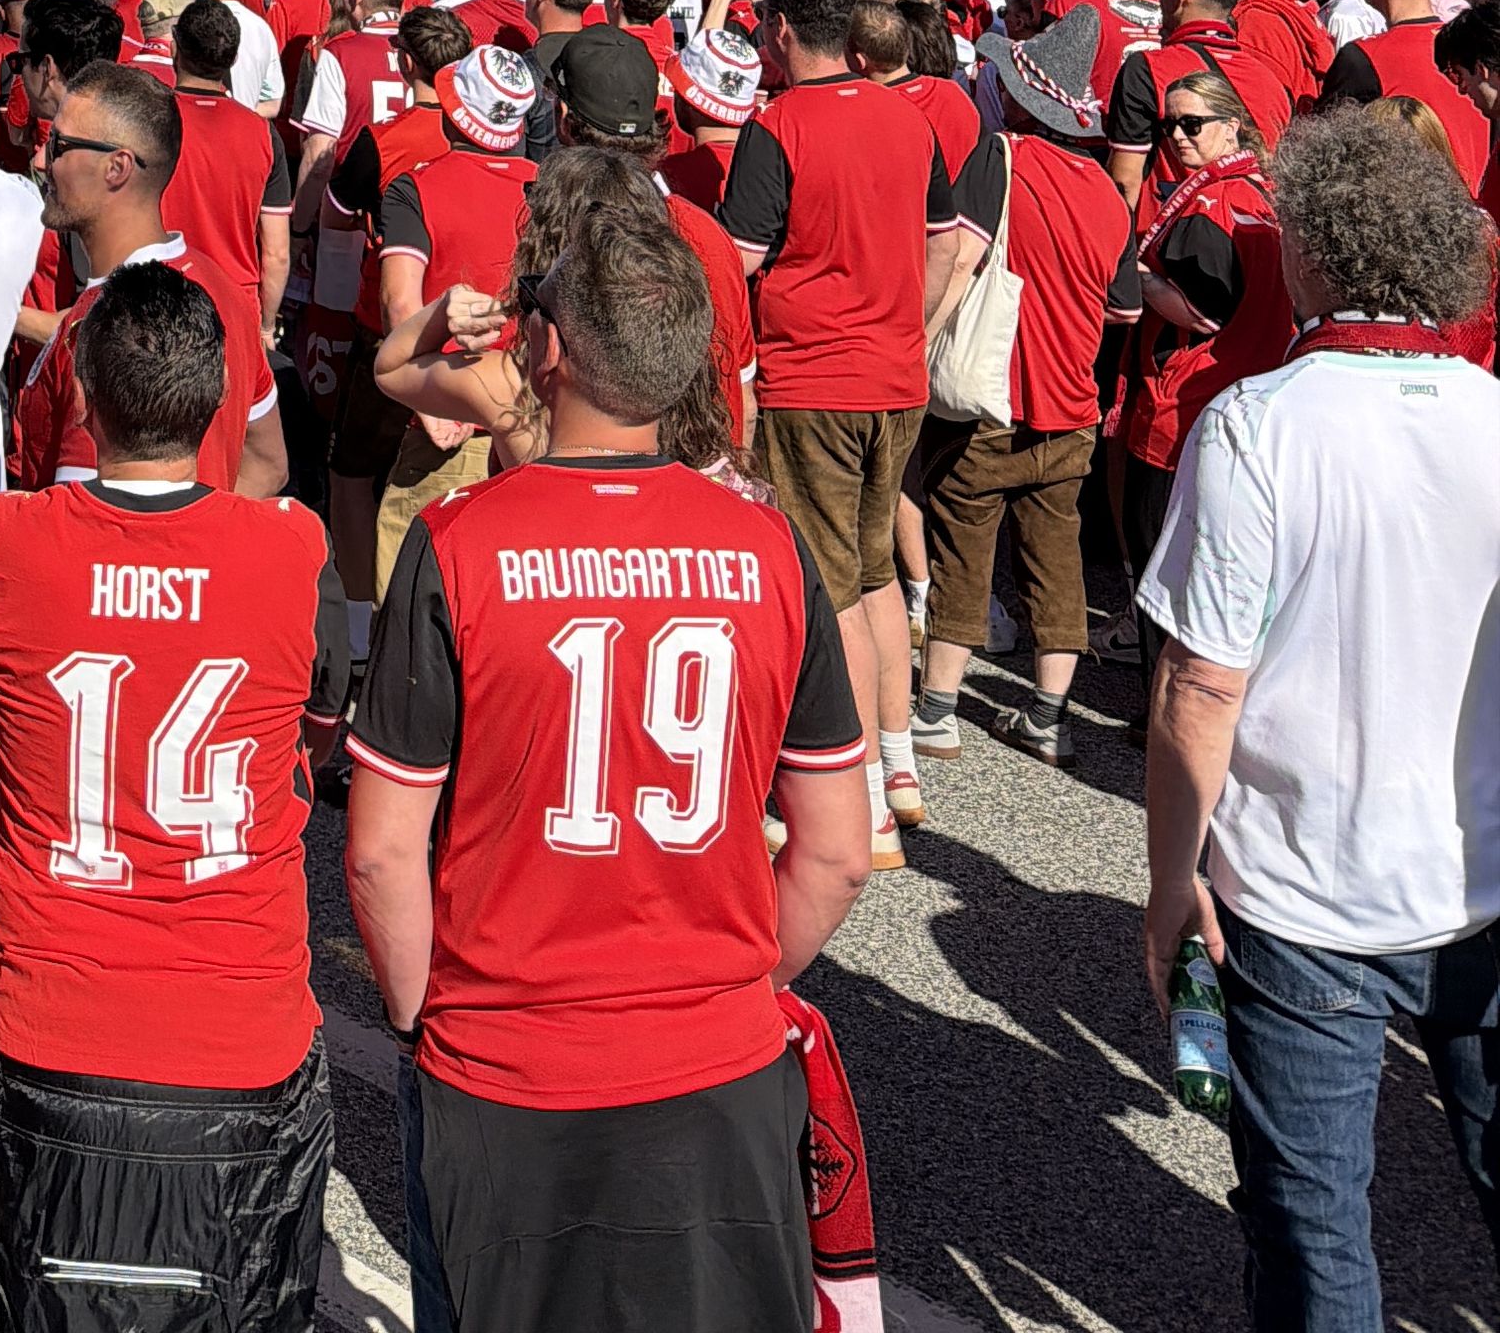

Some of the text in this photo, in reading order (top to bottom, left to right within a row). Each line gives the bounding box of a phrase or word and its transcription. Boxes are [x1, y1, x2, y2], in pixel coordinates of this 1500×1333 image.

[1162, 171, 1210, 217] WIEDER
[91, 564, 209, 621] HORST
[498, 548, 761, 603] BAUMGARTNER
[545, 618, 739, 855] 19
[46, 651, 259, 890] 14
